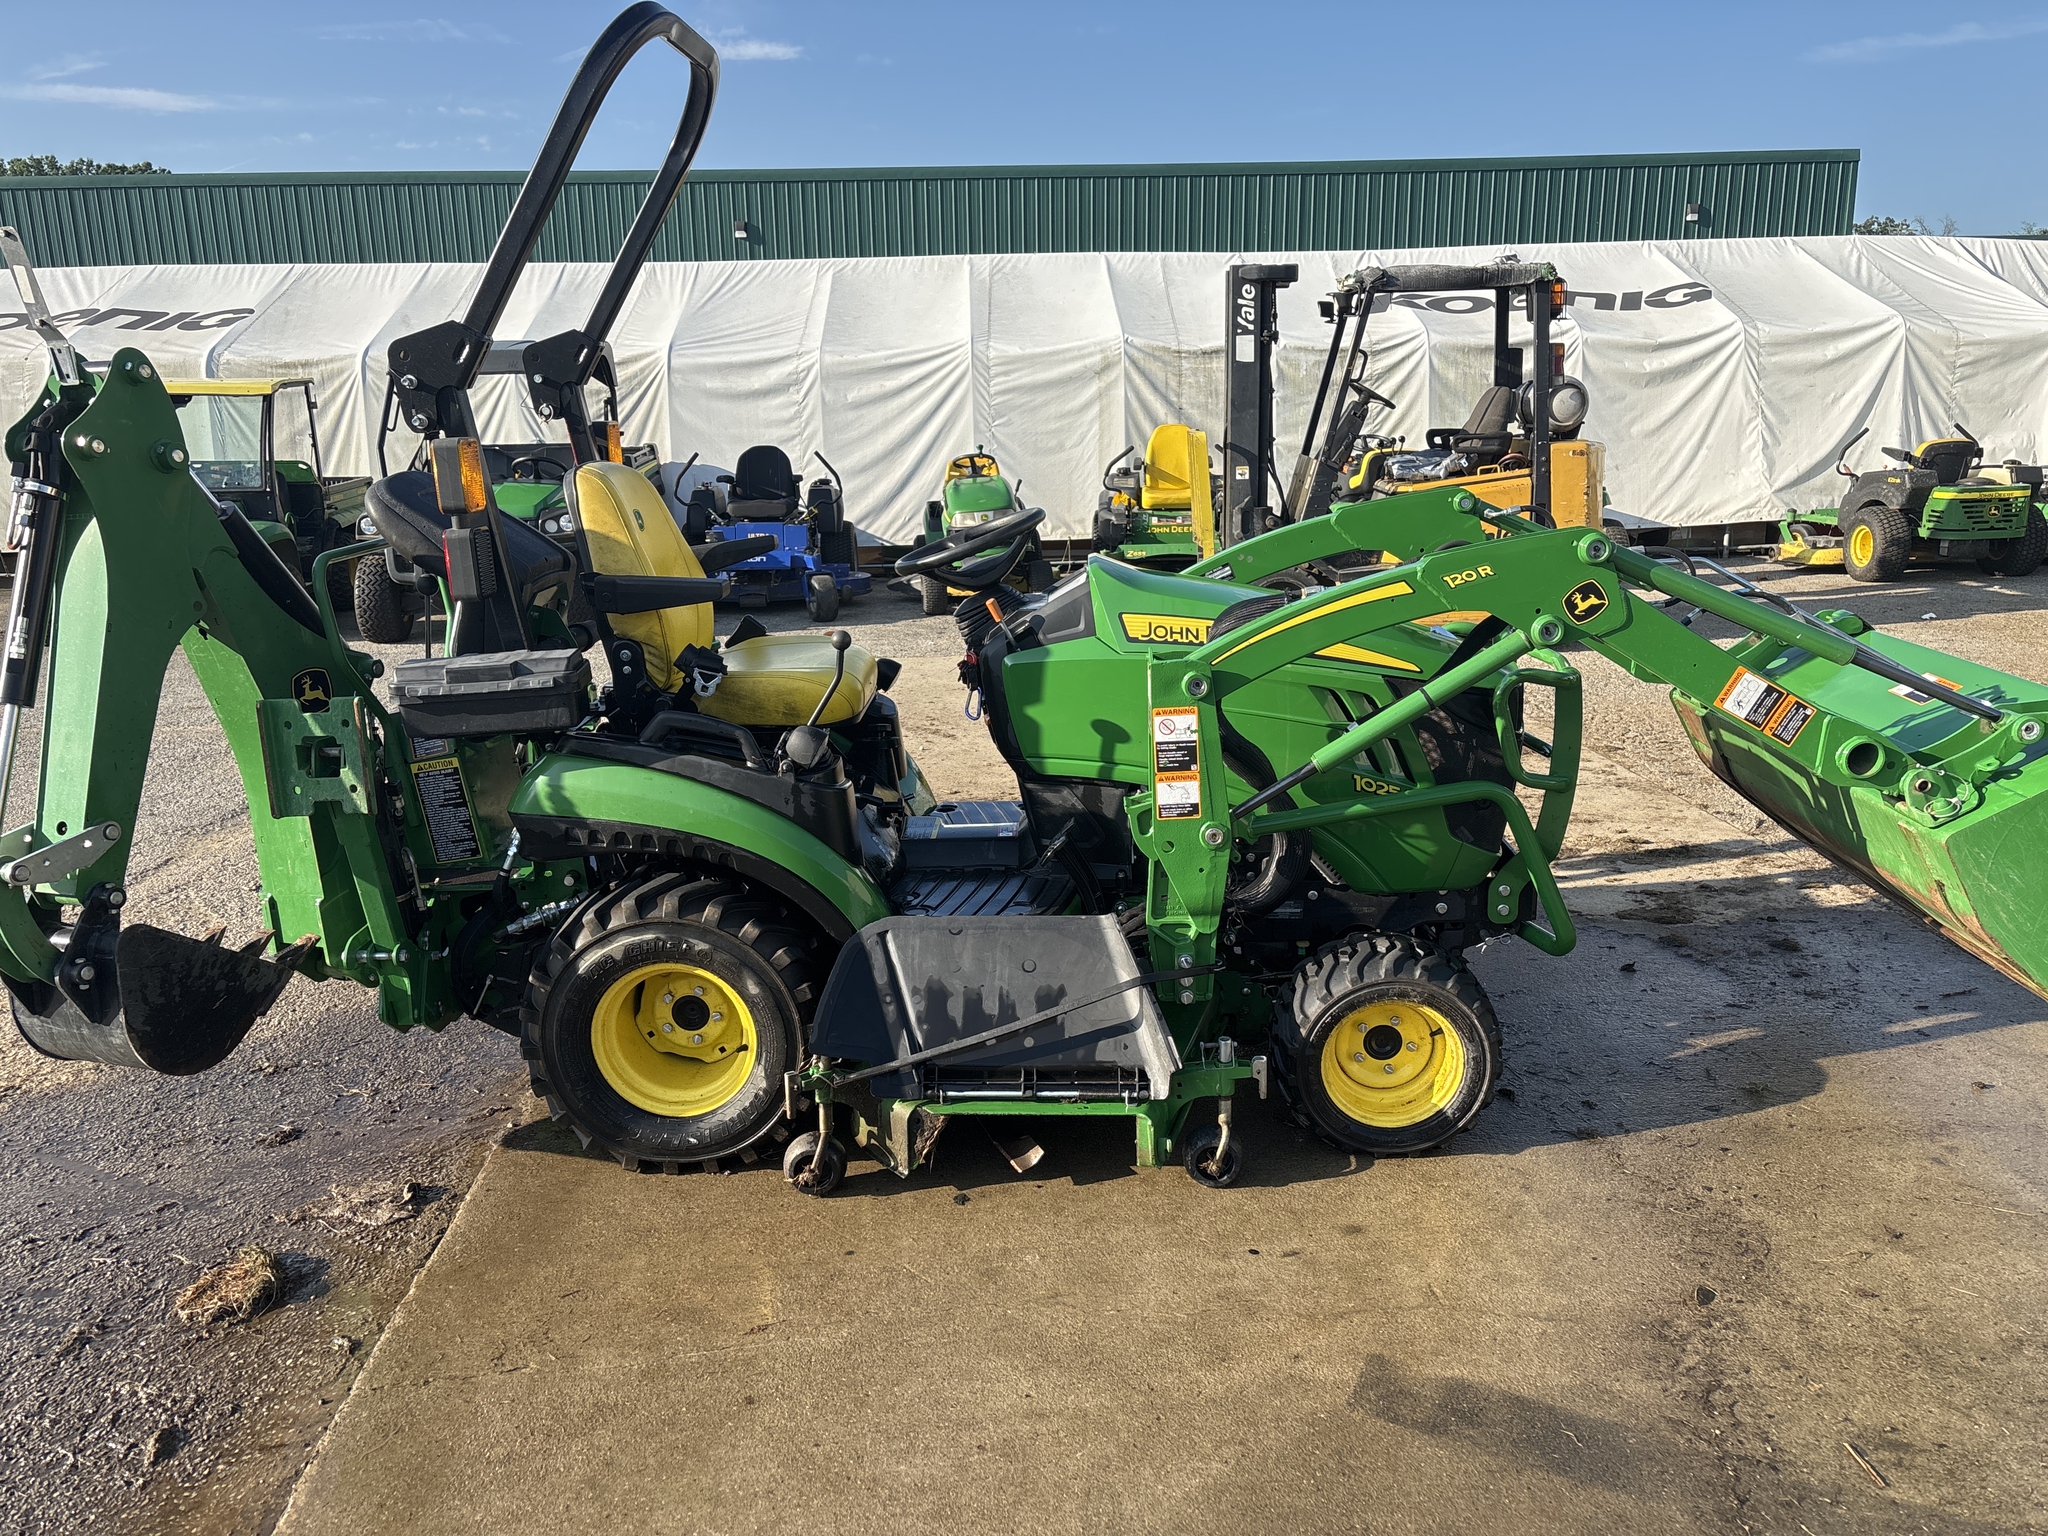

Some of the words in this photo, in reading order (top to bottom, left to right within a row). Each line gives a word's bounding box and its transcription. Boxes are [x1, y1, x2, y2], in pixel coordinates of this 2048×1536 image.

[1237, 284, 1255, 333] Yale
[1442, 570, 1477, 589] 120
[1476, 565, 1495, 578] R
[1140, 621, 1200, 641] JOHN
[1723, 672, 1743, 697] WARNING
[1773, 700, 1793, 725] WARNING
[423, 760, 454, 771] CAUTION
